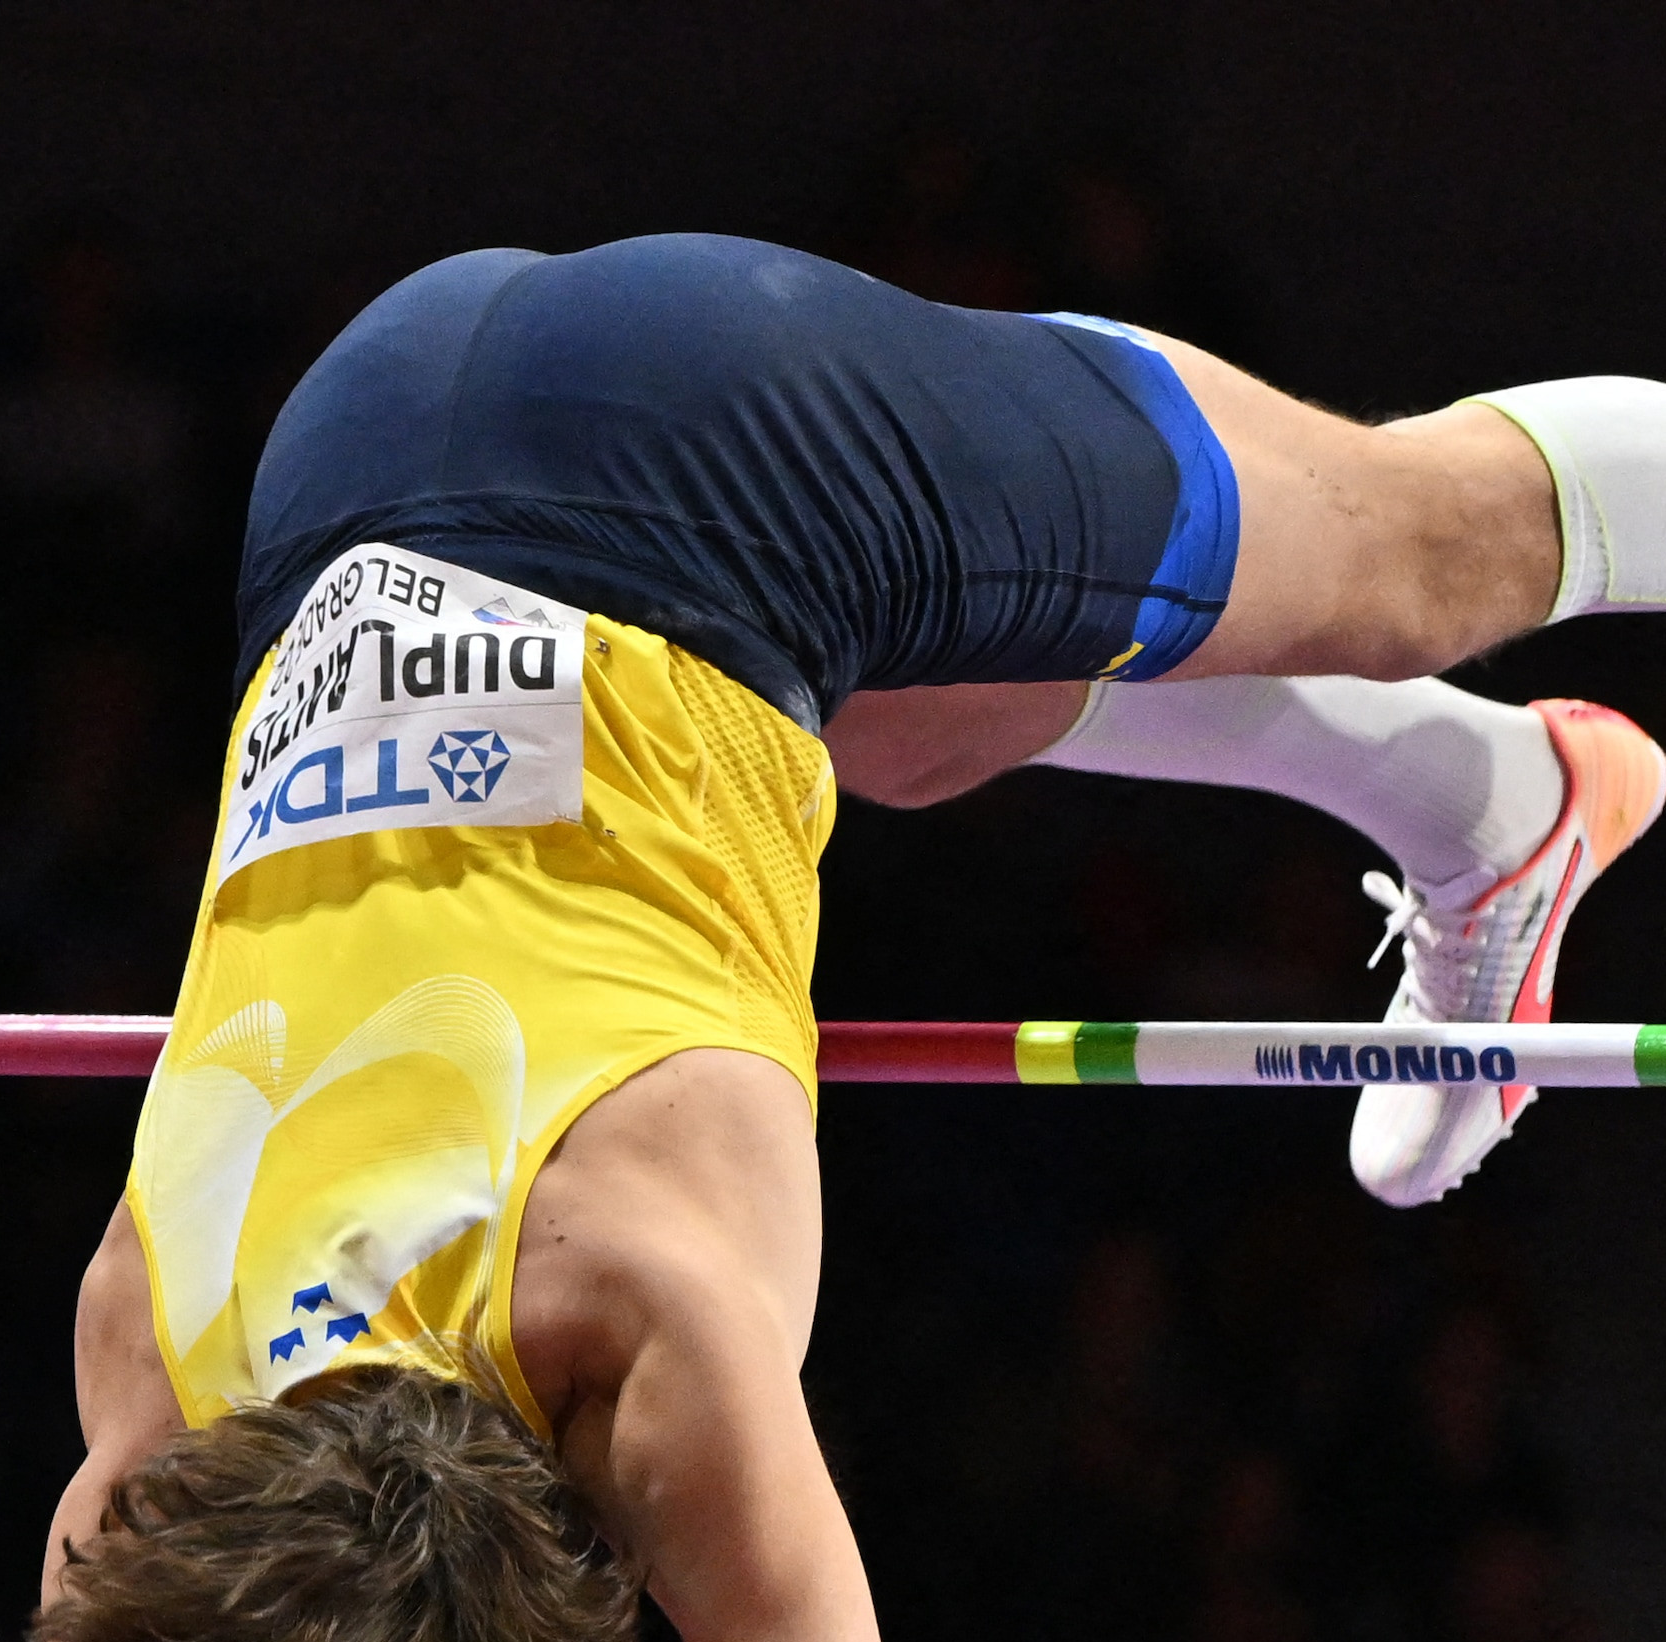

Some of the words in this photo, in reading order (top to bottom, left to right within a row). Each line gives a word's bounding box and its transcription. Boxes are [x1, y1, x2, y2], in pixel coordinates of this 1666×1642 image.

[241, 619, 556, 791] DUPLANTIS
[229, 738, 429, 864] TDK
[1297, 1044, 1517, 1082] MONDO
